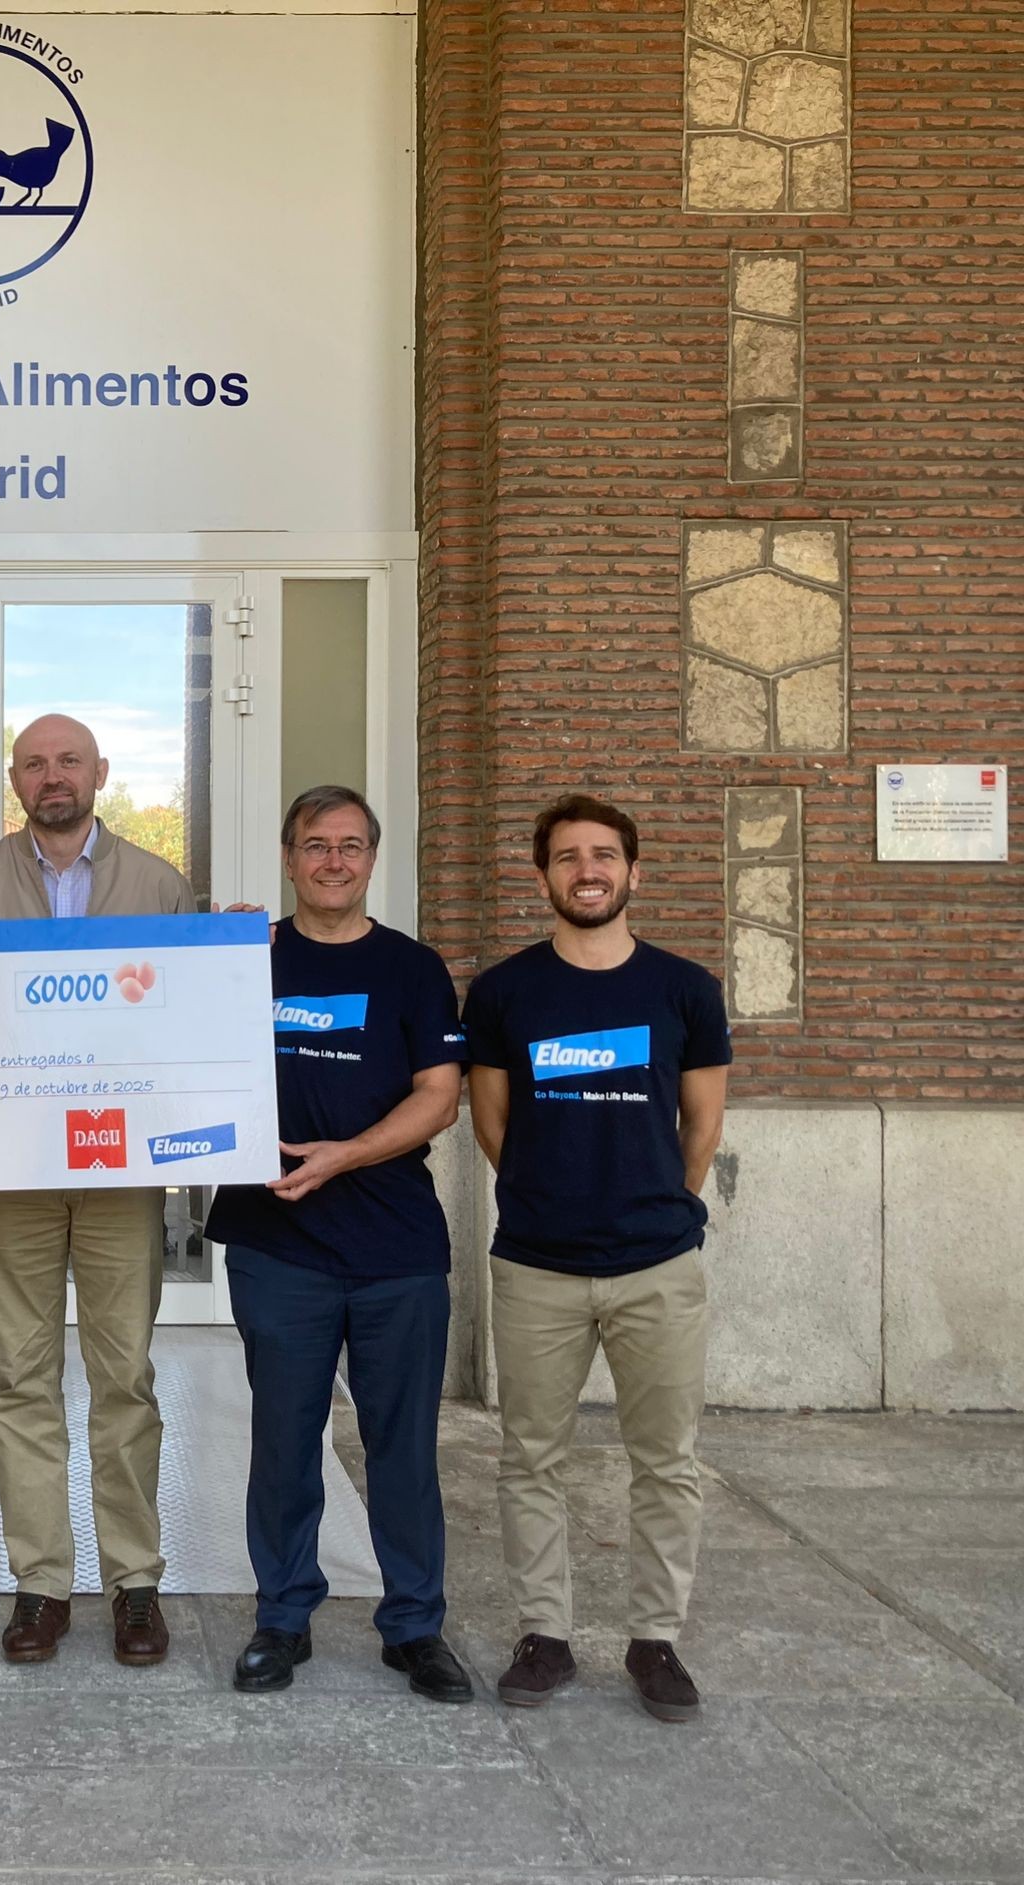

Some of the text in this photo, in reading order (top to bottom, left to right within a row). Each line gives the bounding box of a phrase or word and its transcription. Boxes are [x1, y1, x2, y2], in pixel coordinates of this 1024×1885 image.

[25, 973, 109, 1005] 60000
[273, 1001, 334, 1029] lanco
[0, 1052, 95, 1069] entregados a
[298, 1047, 320, 1058] Make
[321, 1049, 335, 1058] Life
[337, 1051, 362, 1061] Better.
[535, 1042, 616, 1067] Elanco
[0, 1080, 155, 1099] 9 de octubre de 2025
[535, 1090, 649, 1102] Go Beyond. Make Life Better.
[74, 1129, 121, 1147] DAGU
[153, 1138, 212, 1155] Elanco
